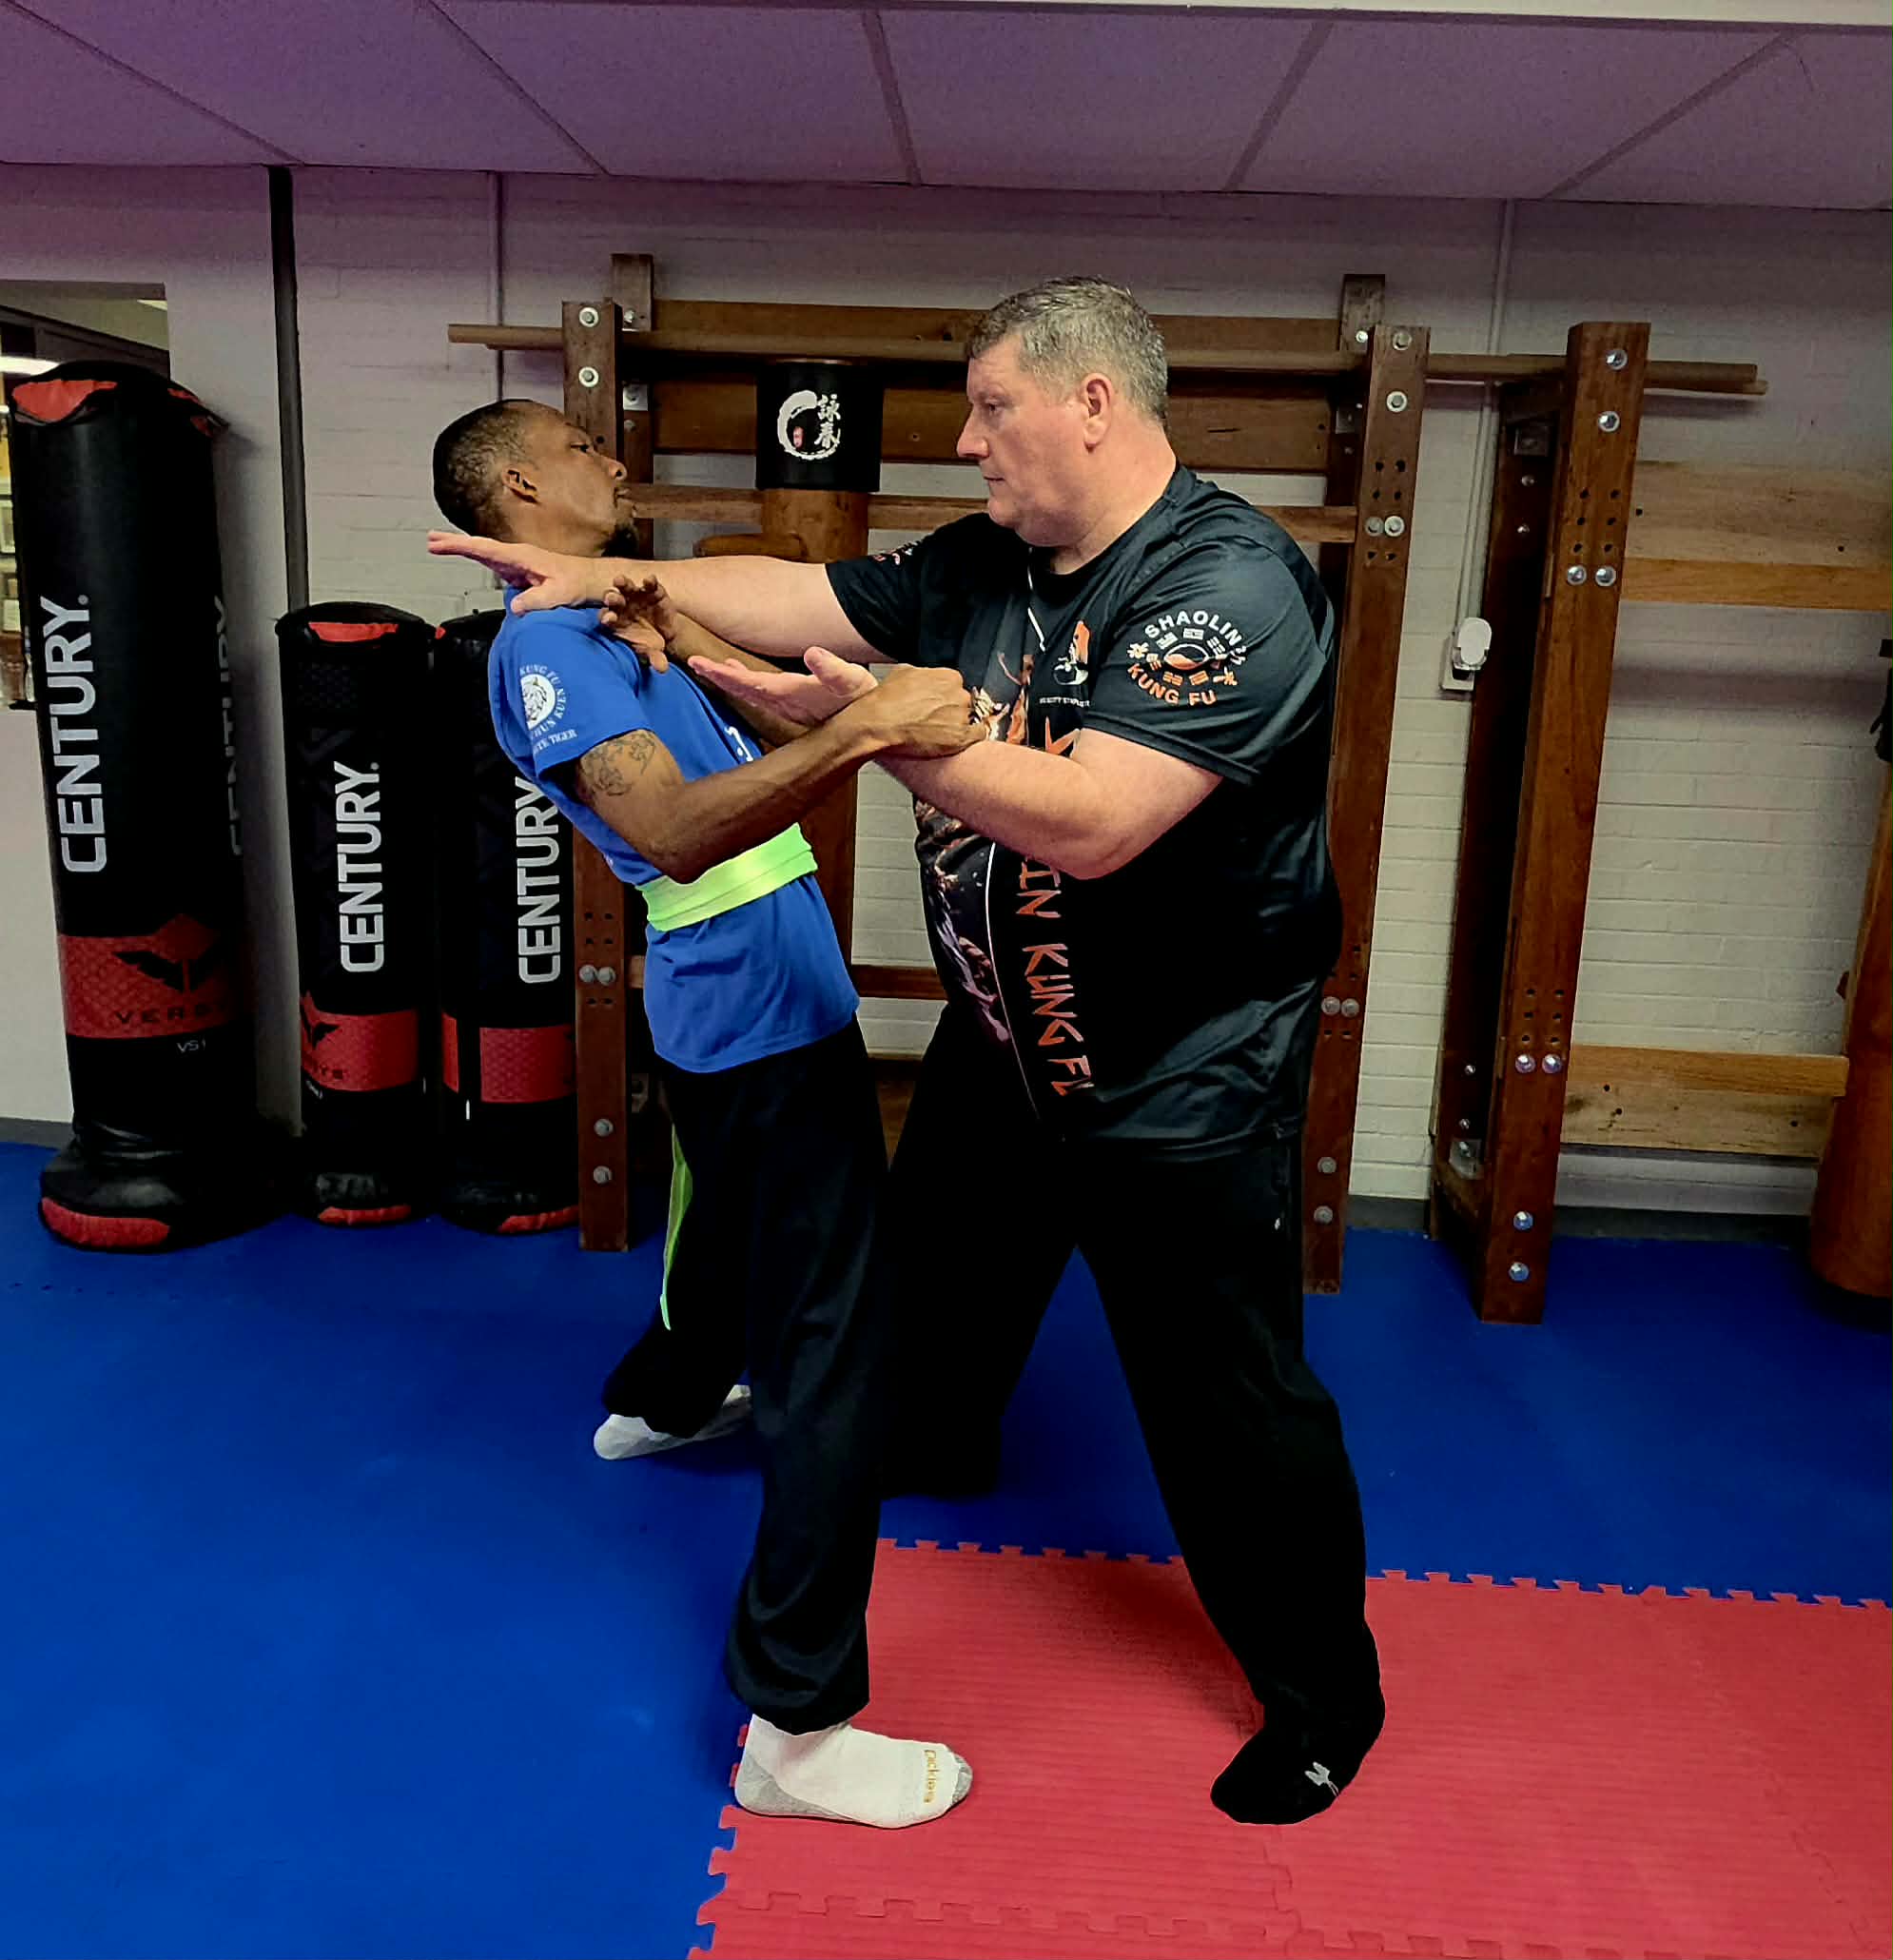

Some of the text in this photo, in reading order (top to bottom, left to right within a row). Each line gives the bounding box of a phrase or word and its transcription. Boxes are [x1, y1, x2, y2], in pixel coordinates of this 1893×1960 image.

[1144, 610, 1242, 646] SHAOLIN
[1127, 663, 1218, 706] KUNG FU
[1022, 943, 1084, 1047] KUNG
